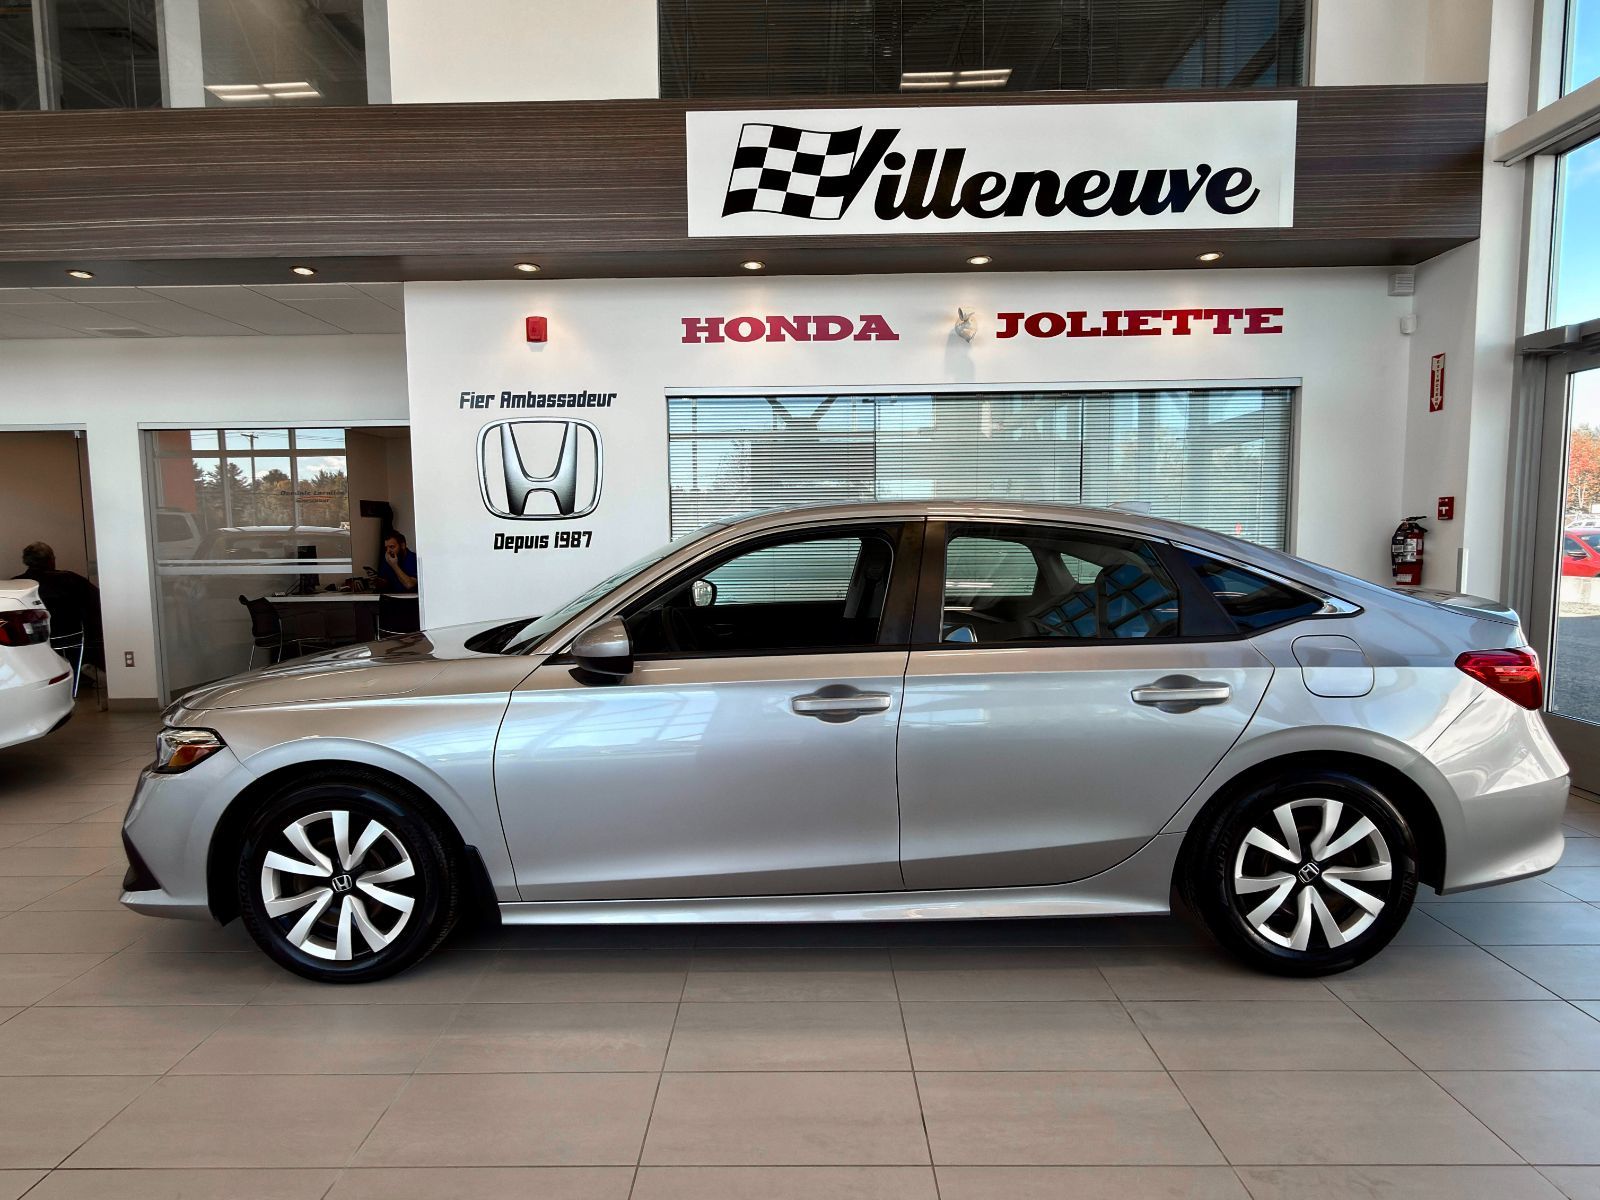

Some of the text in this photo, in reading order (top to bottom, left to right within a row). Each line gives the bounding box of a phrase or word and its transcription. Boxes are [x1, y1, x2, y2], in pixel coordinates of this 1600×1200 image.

[838, 126, 1261, 221] Villeneuve
[681, 307, 1284, 344] HONDA JOLIETTE
[459, 390, 618, 409] Fier Ambassadeur
[493, 530, 593, 554] Depuis 1987
